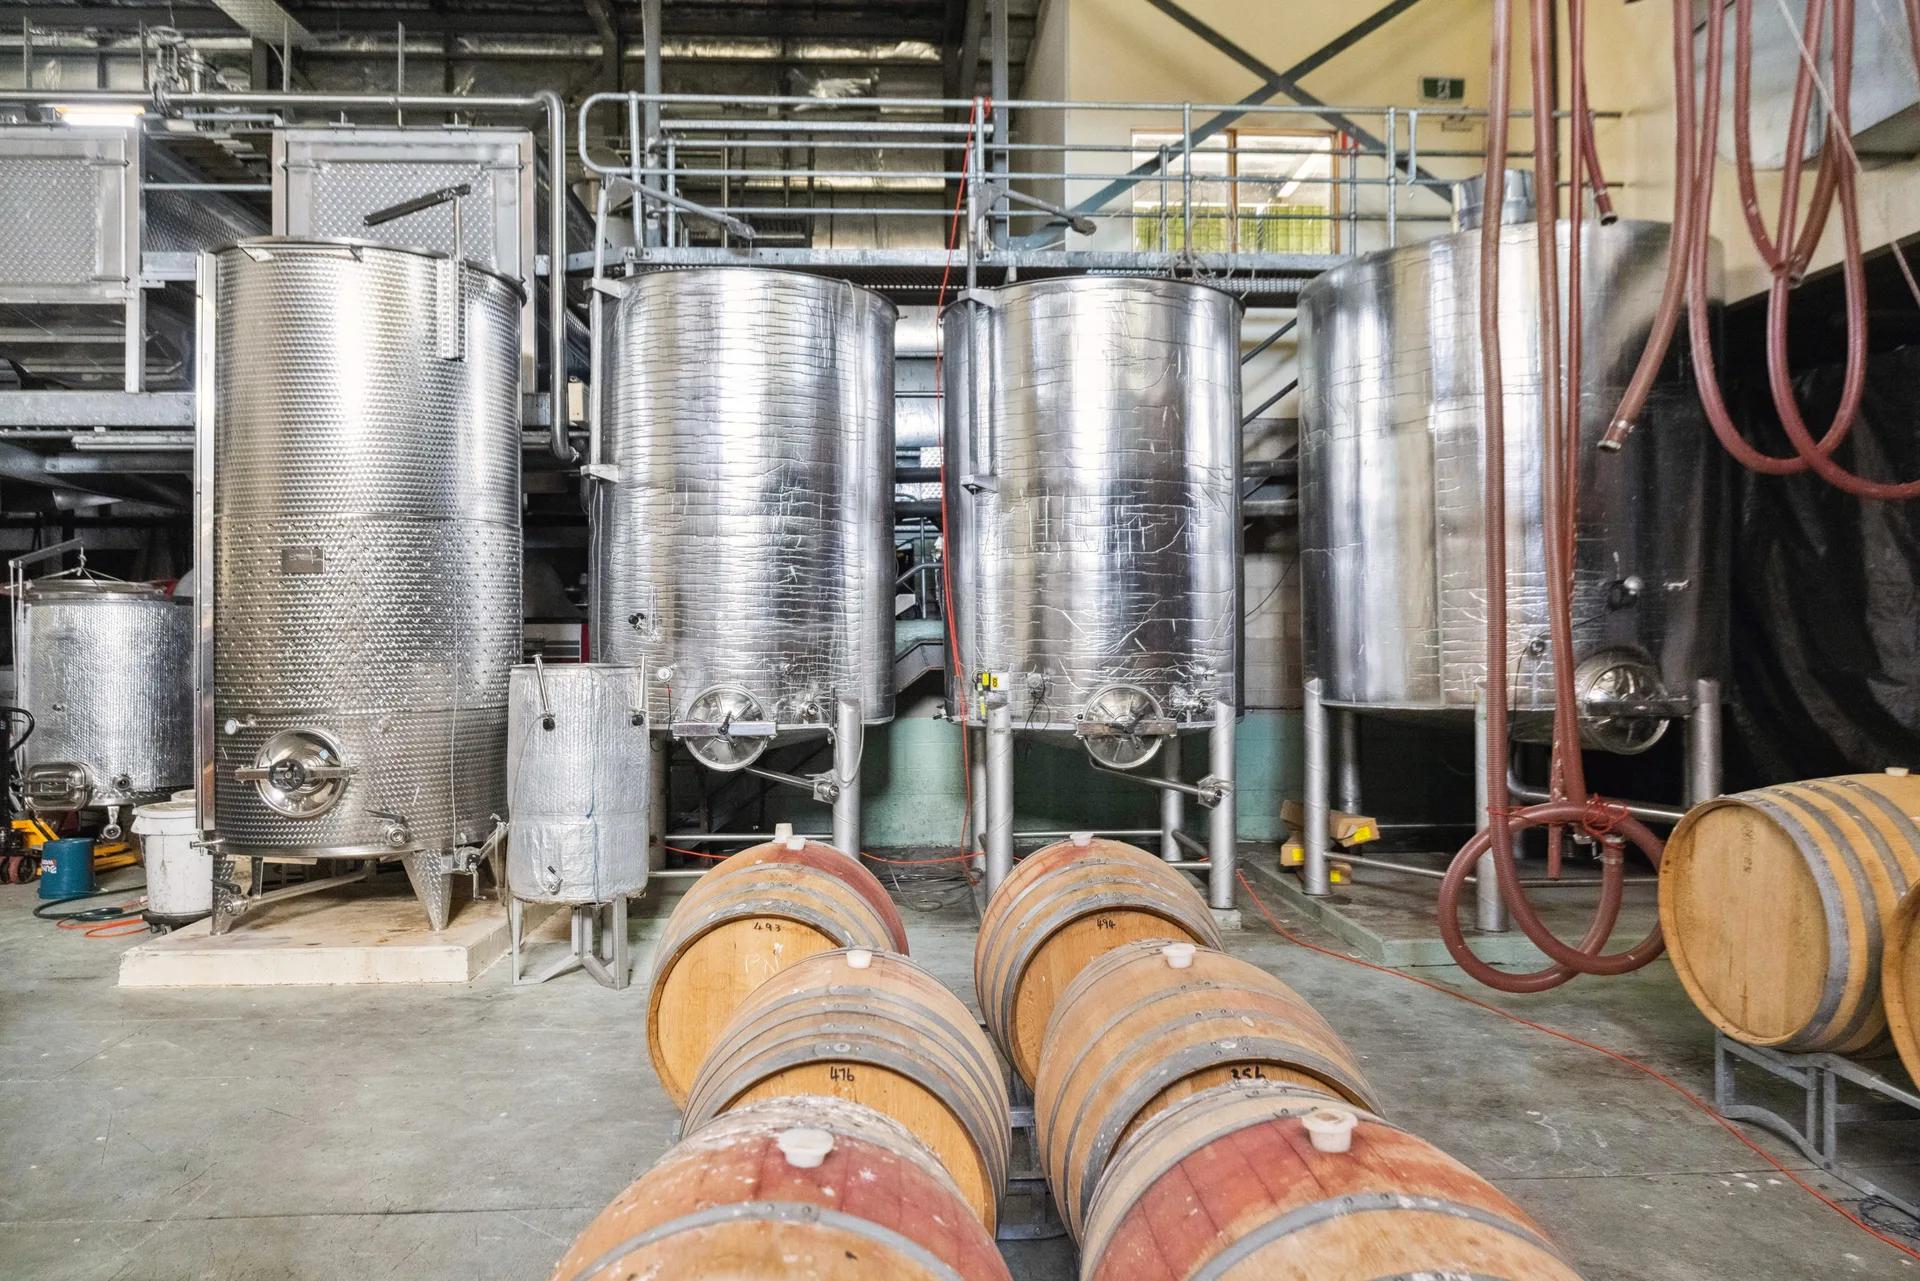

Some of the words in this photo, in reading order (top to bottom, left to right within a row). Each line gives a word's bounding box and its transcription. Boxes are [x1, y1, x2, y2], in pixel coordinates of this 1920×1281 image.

[753, 922, 781, 932] 493
[1096, 918, 1116, 930] 494
[830, 1066, 854, 1082] 476
